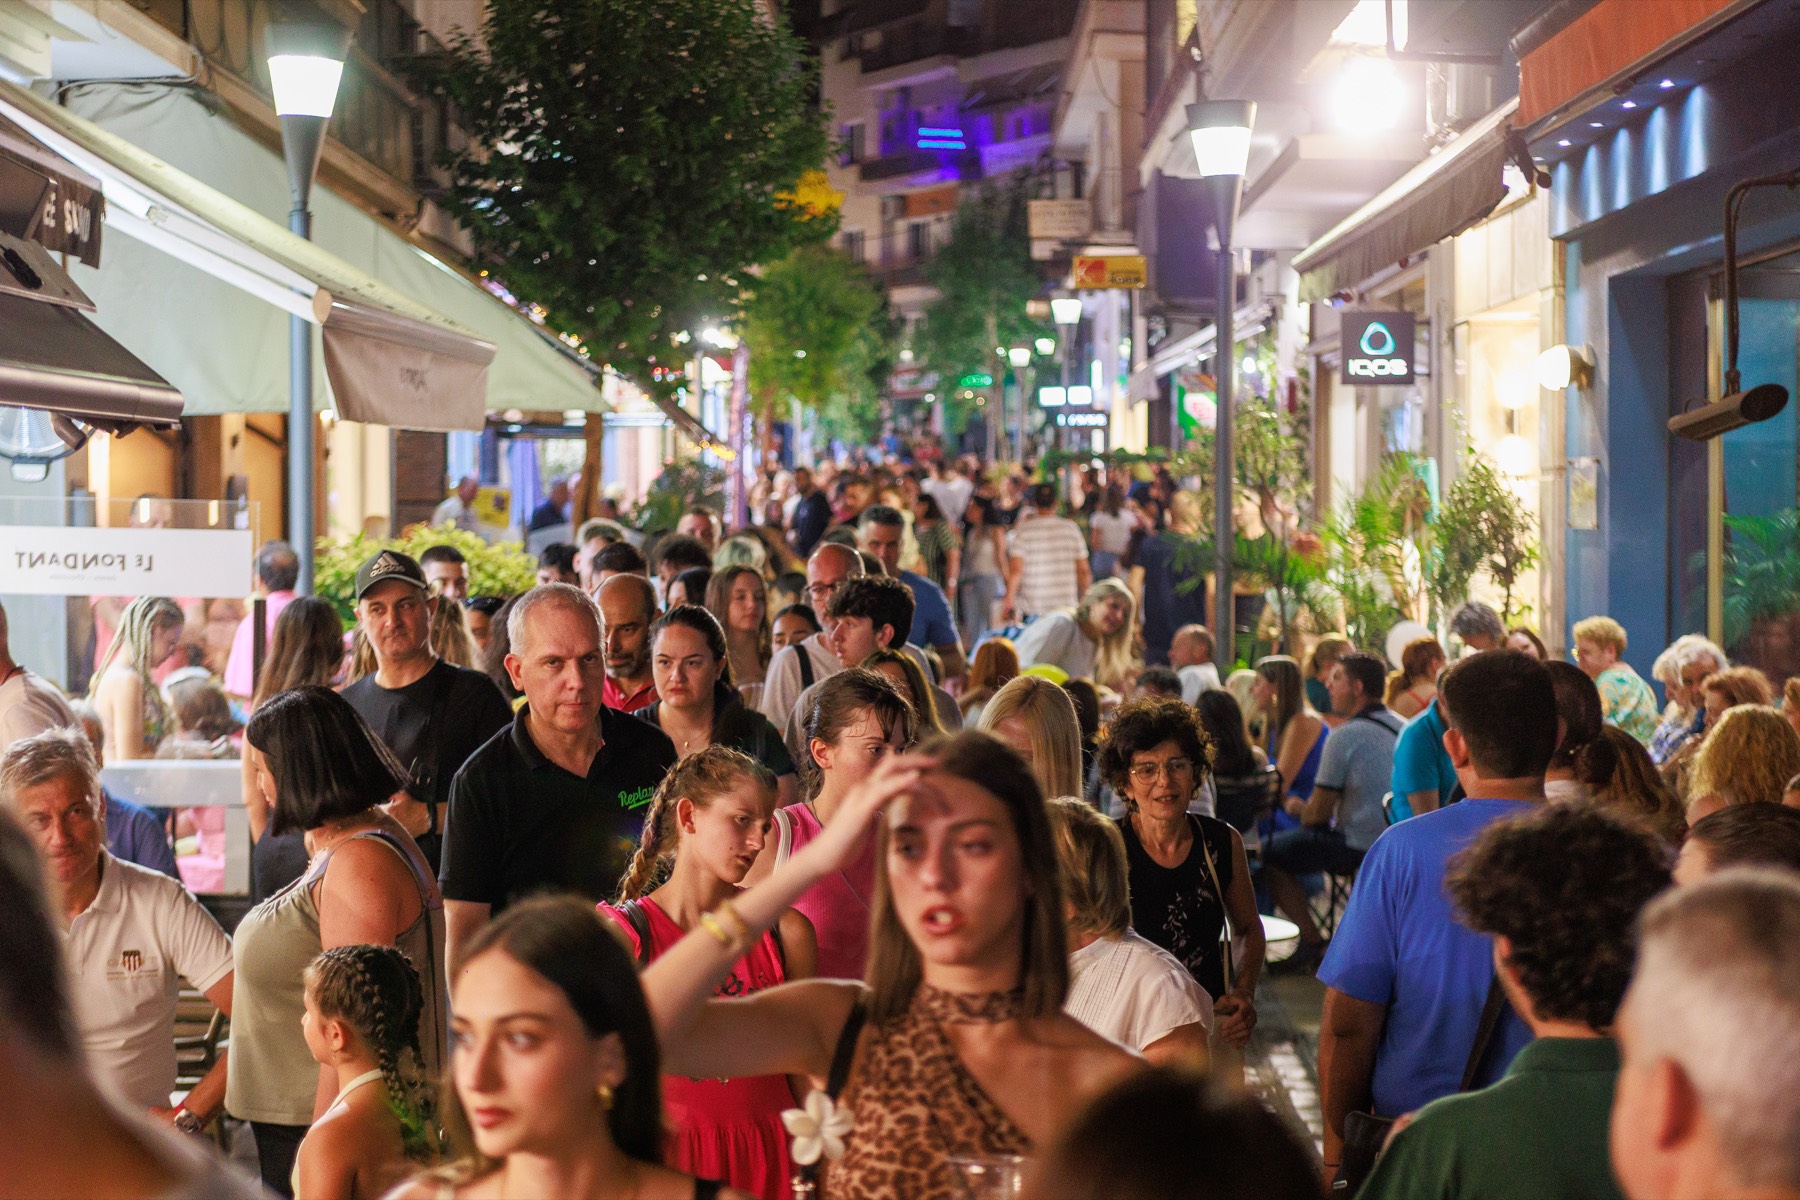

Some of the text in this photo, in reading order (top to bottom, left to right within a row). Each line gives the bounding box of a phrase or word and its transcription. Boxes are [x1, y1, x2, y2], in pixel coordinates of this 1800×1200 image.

[1348, 358, 1408, 378] IQOS
[369, 564, 406, 578] adidas
[617, 785, 655, 808] Replay
